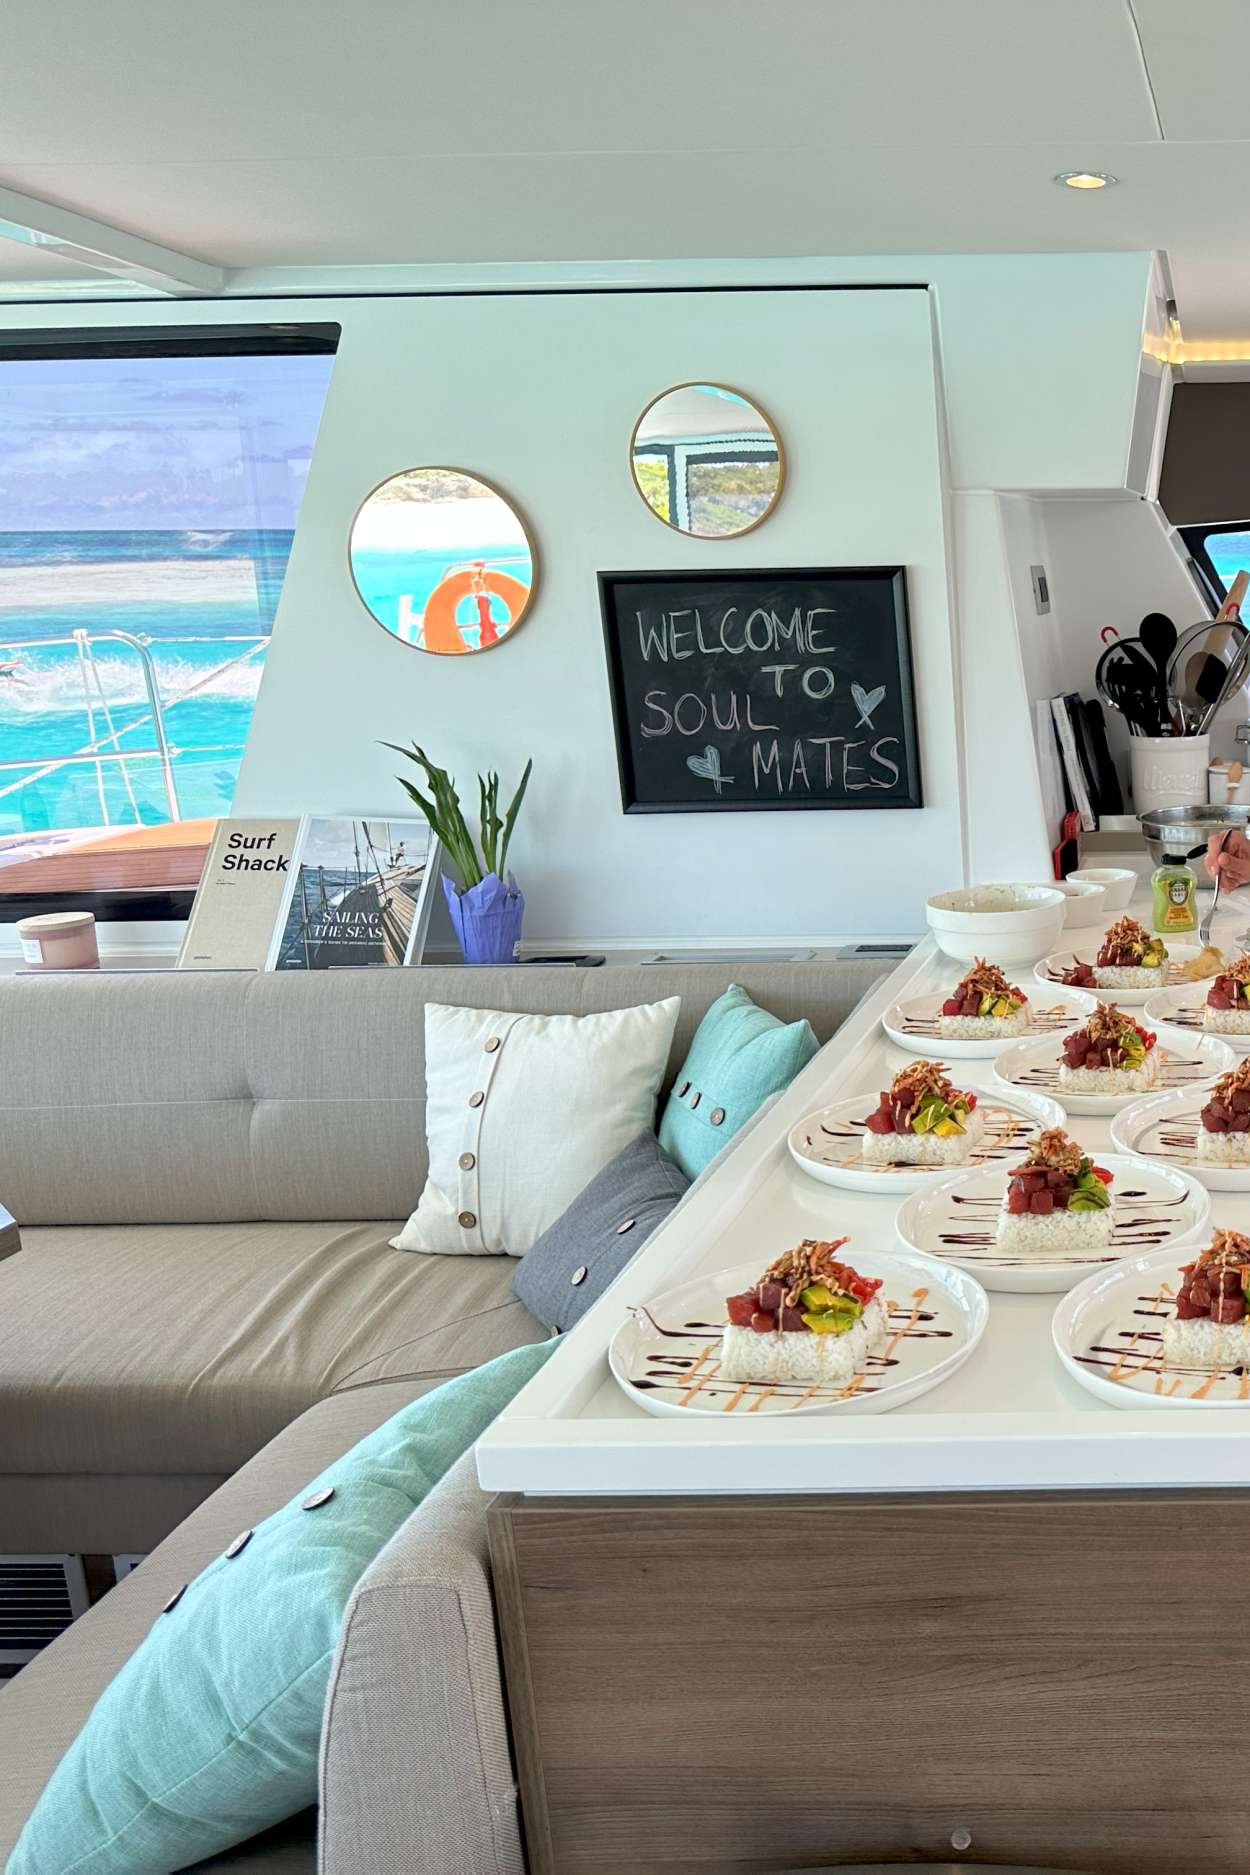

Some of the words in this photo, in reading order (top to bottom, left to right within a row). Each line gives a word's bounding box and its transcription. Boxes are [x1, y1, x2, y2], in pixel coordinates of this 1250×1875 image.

[636, 607, 837, 662] WELCOME
[760, 664, 835, 699] TO
[640, 690, 780, 738] SOUL
[752, 736, 900, 796] MATES
[227, 832, 277, 849] Surf
[221, 854, 290, 872] Shack
[323, 911, 379, 924] SAILING
[313, 925, 343, 937] THE
[345, 926, 384, 938] SEAS
